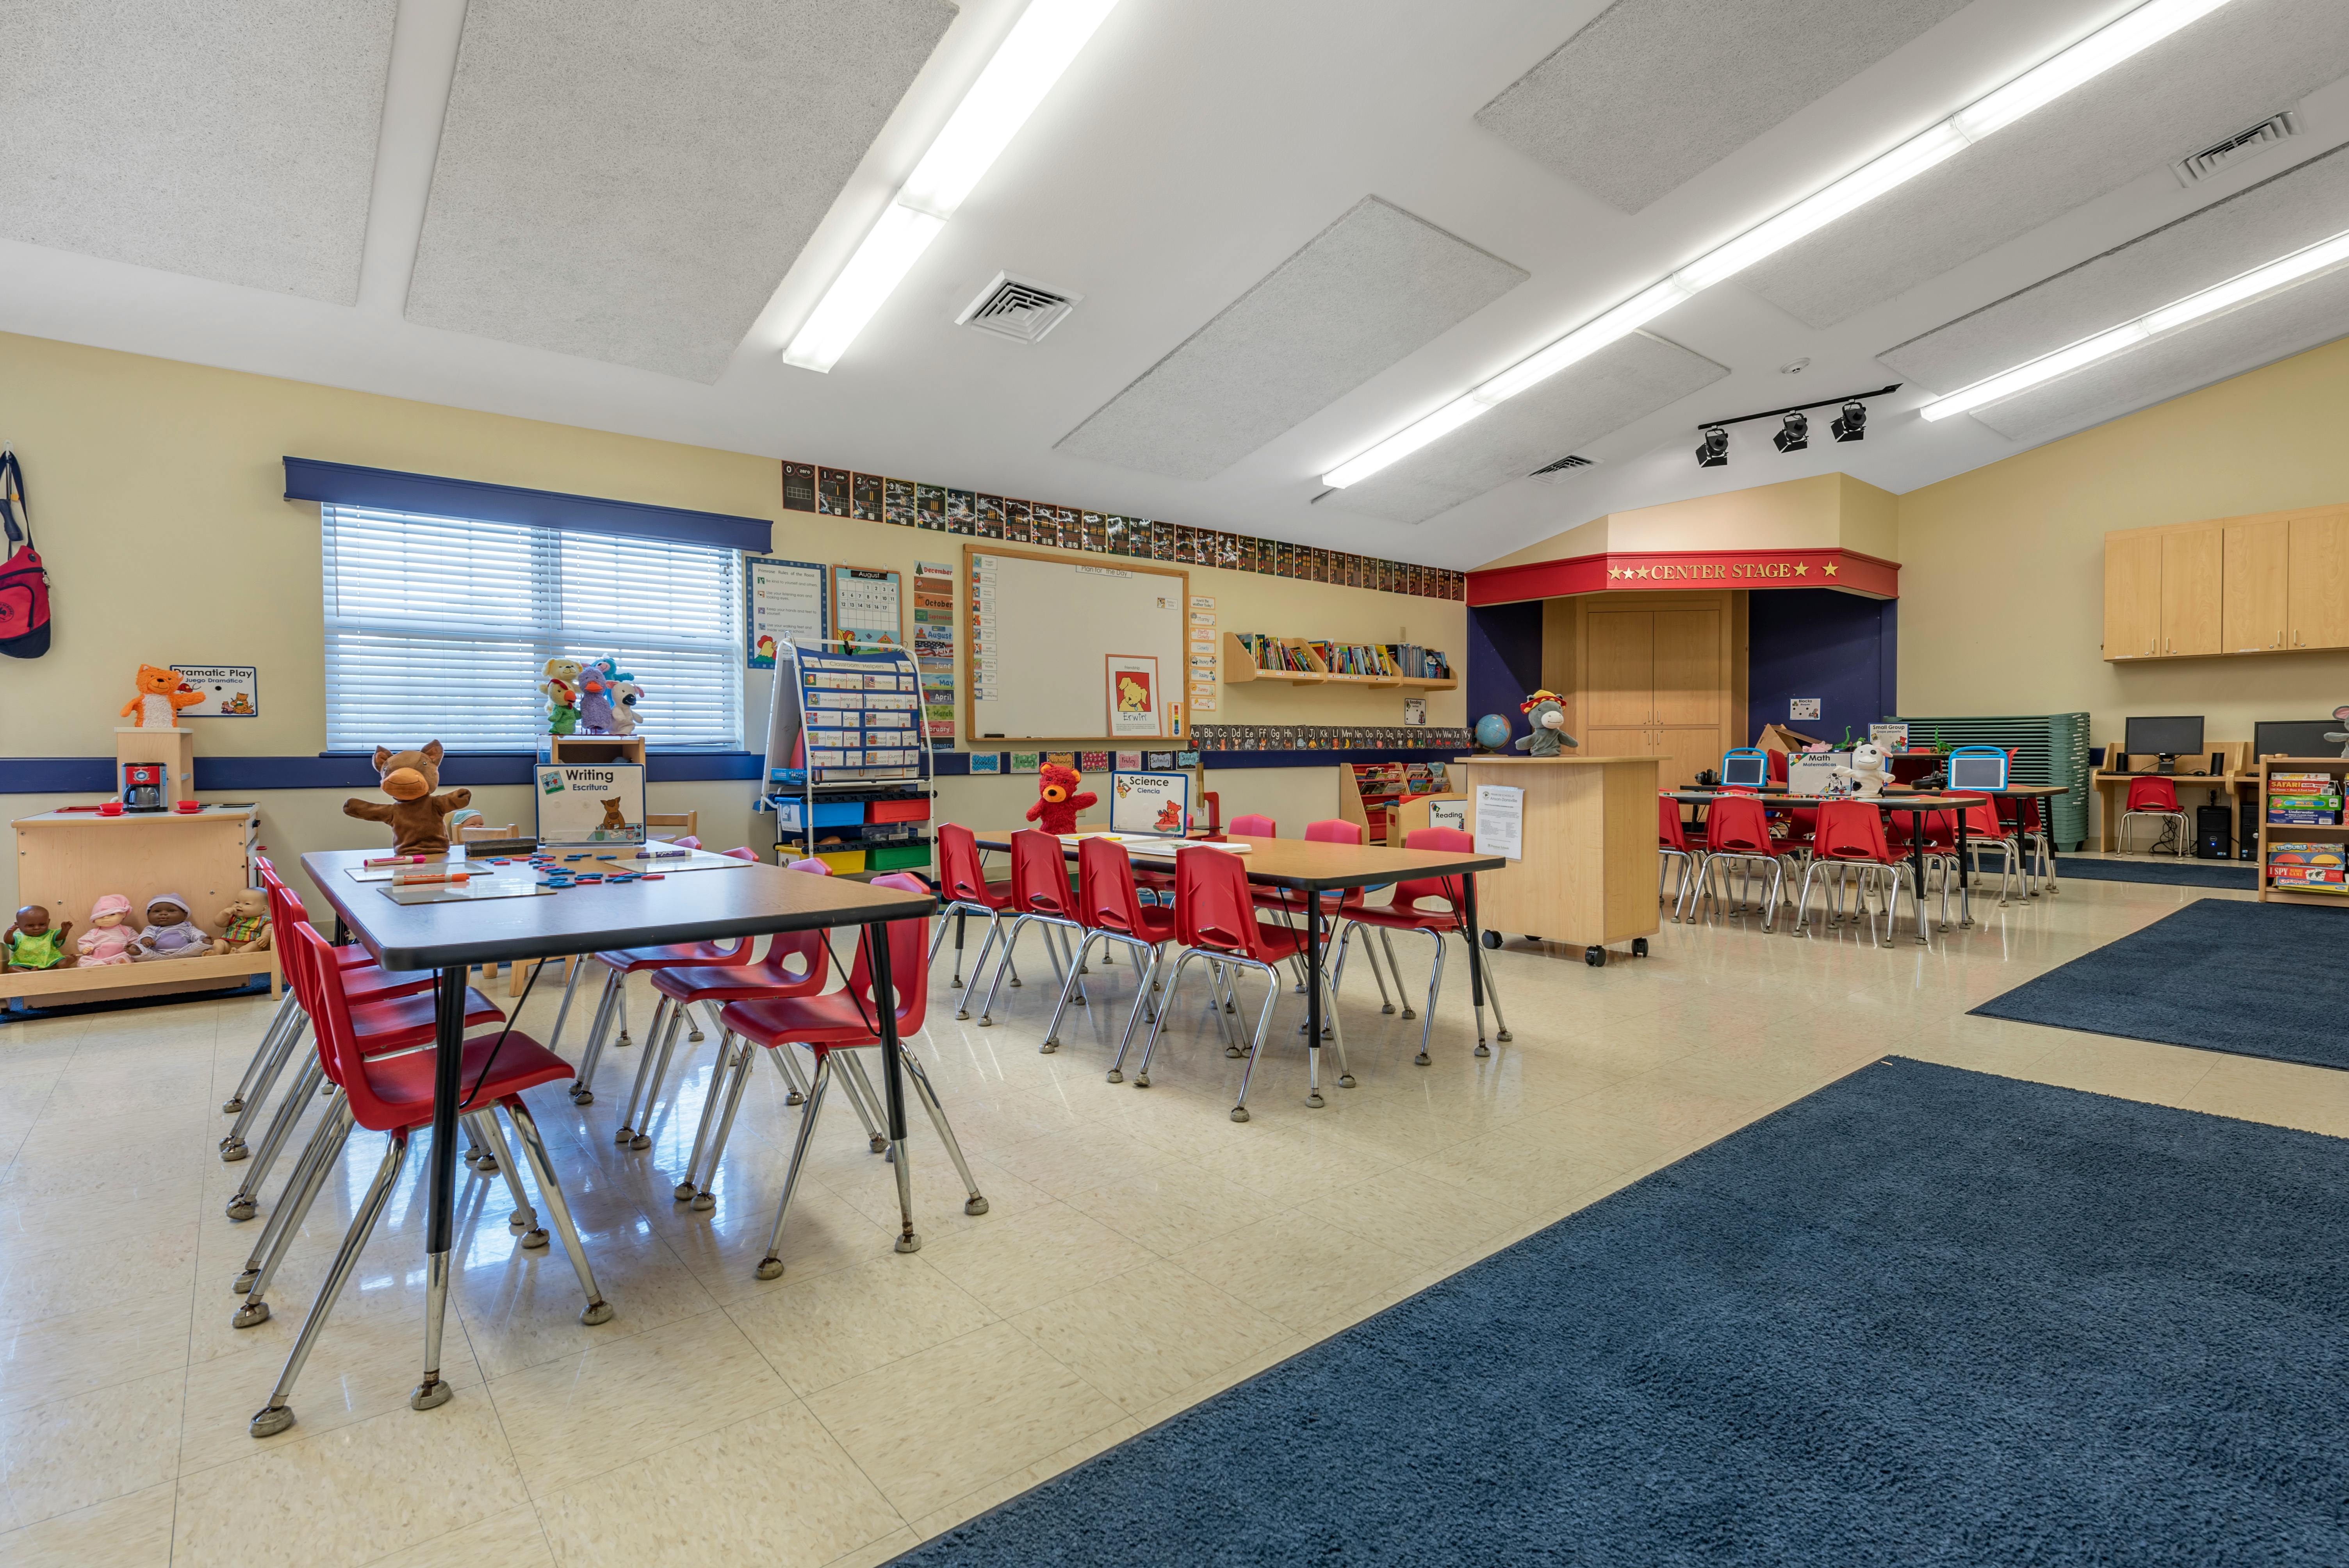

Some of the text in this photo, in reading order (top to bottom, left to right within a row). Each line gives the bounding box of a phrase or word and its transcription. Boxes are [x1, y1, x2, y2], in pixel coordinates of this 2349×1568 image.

[924, 567, 952, 575] December
[1650, 564, 1790, 580] CENTER STAGE
[925, 599, 953, 608] October
[928, 631, 952, 640] August
[935, 646, 950, 654] July
[230, 670, 252, 678] Play
[935, 693, 952, 703] April
[1123, 713, 1146, 721] Erwin
[1190, 728, 1199, 738] Aa
[1204, 728, 1213, 737] Bb
[1218, 728, 1227, 737] Cc
[1232, 728, 1240, 737] Dd
[1245, 728, 1253, 737] Ee
[1259, 728, 1266, 737] Ff
[1271, 728, 1280, 739] Gg
[1284, 729, 1292, 737] Hh
[1297, 728, 1303, 737] Ii
[1309, 729, 1315, 739] Jj
[1320, 729, 1328, 738] Kk
[1333, 729, 1338, 737] Ll
[1377, 730, 1383, 739] Pp
[1387, 731, 1394, 739] Qq
[1463, 731, 1470, 739] Yy
[1015, 757, 1035, 766] Tuesday
[1122, 757, 1135, 766] Friday
[1182, 755, 1196, 763] Sunday
[566, 769, 614, 783] Writing
[1130, 776, 1169, 786] Science
